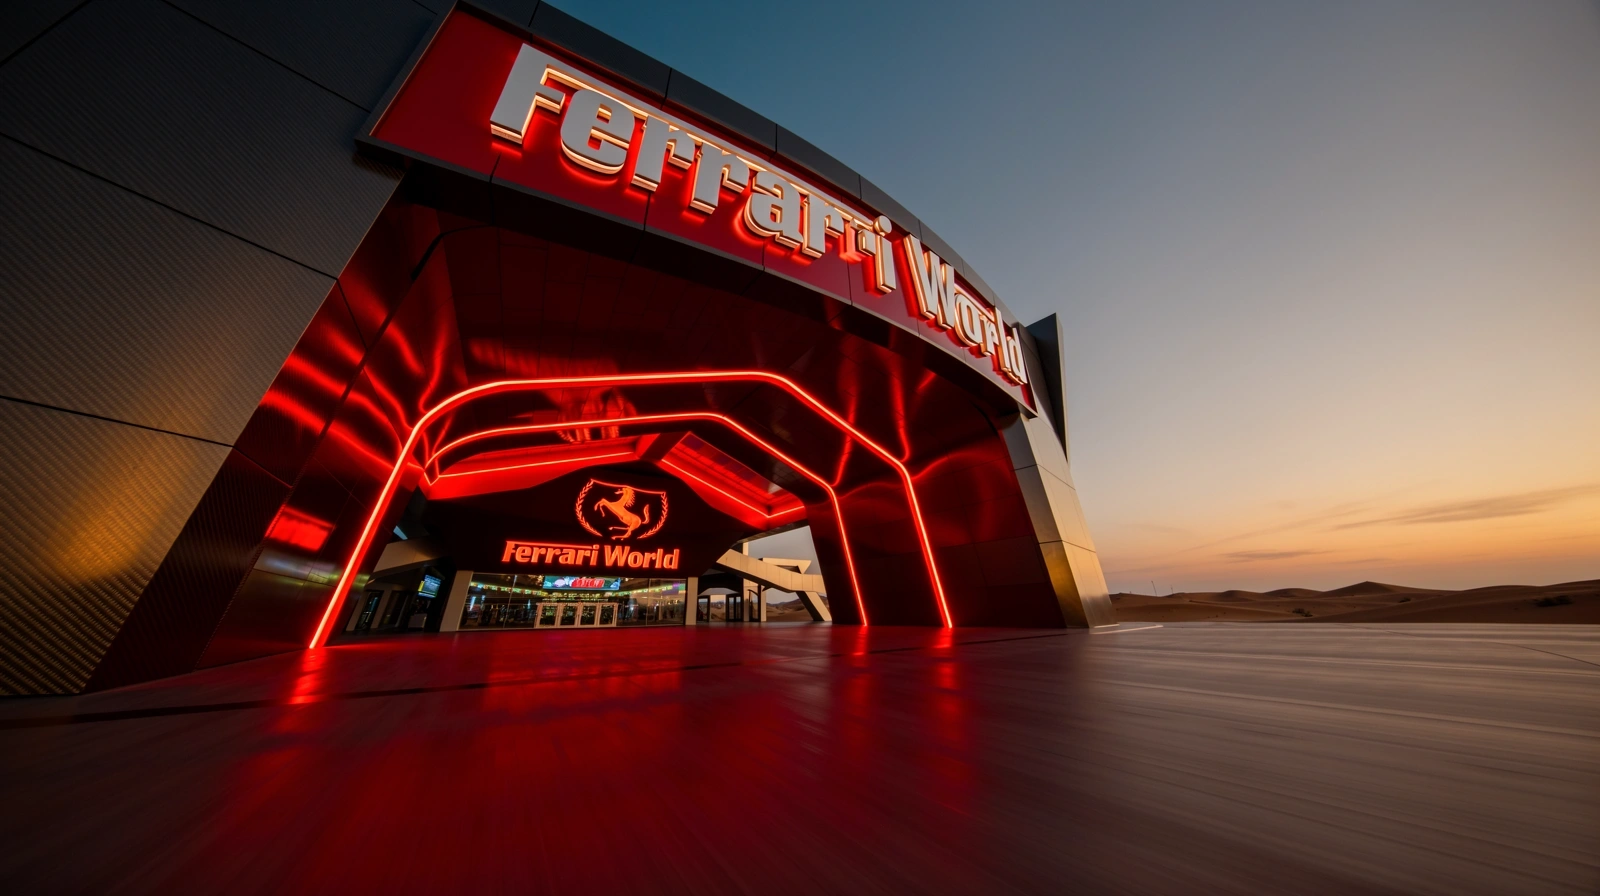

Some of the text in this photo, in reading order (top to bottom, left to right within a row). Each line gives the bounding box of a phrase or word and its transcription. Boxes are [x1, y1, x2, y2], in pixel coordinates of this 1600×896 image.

[903, 233, 1028, 385] World
[502, 540, 680, 569] Ferrari World
